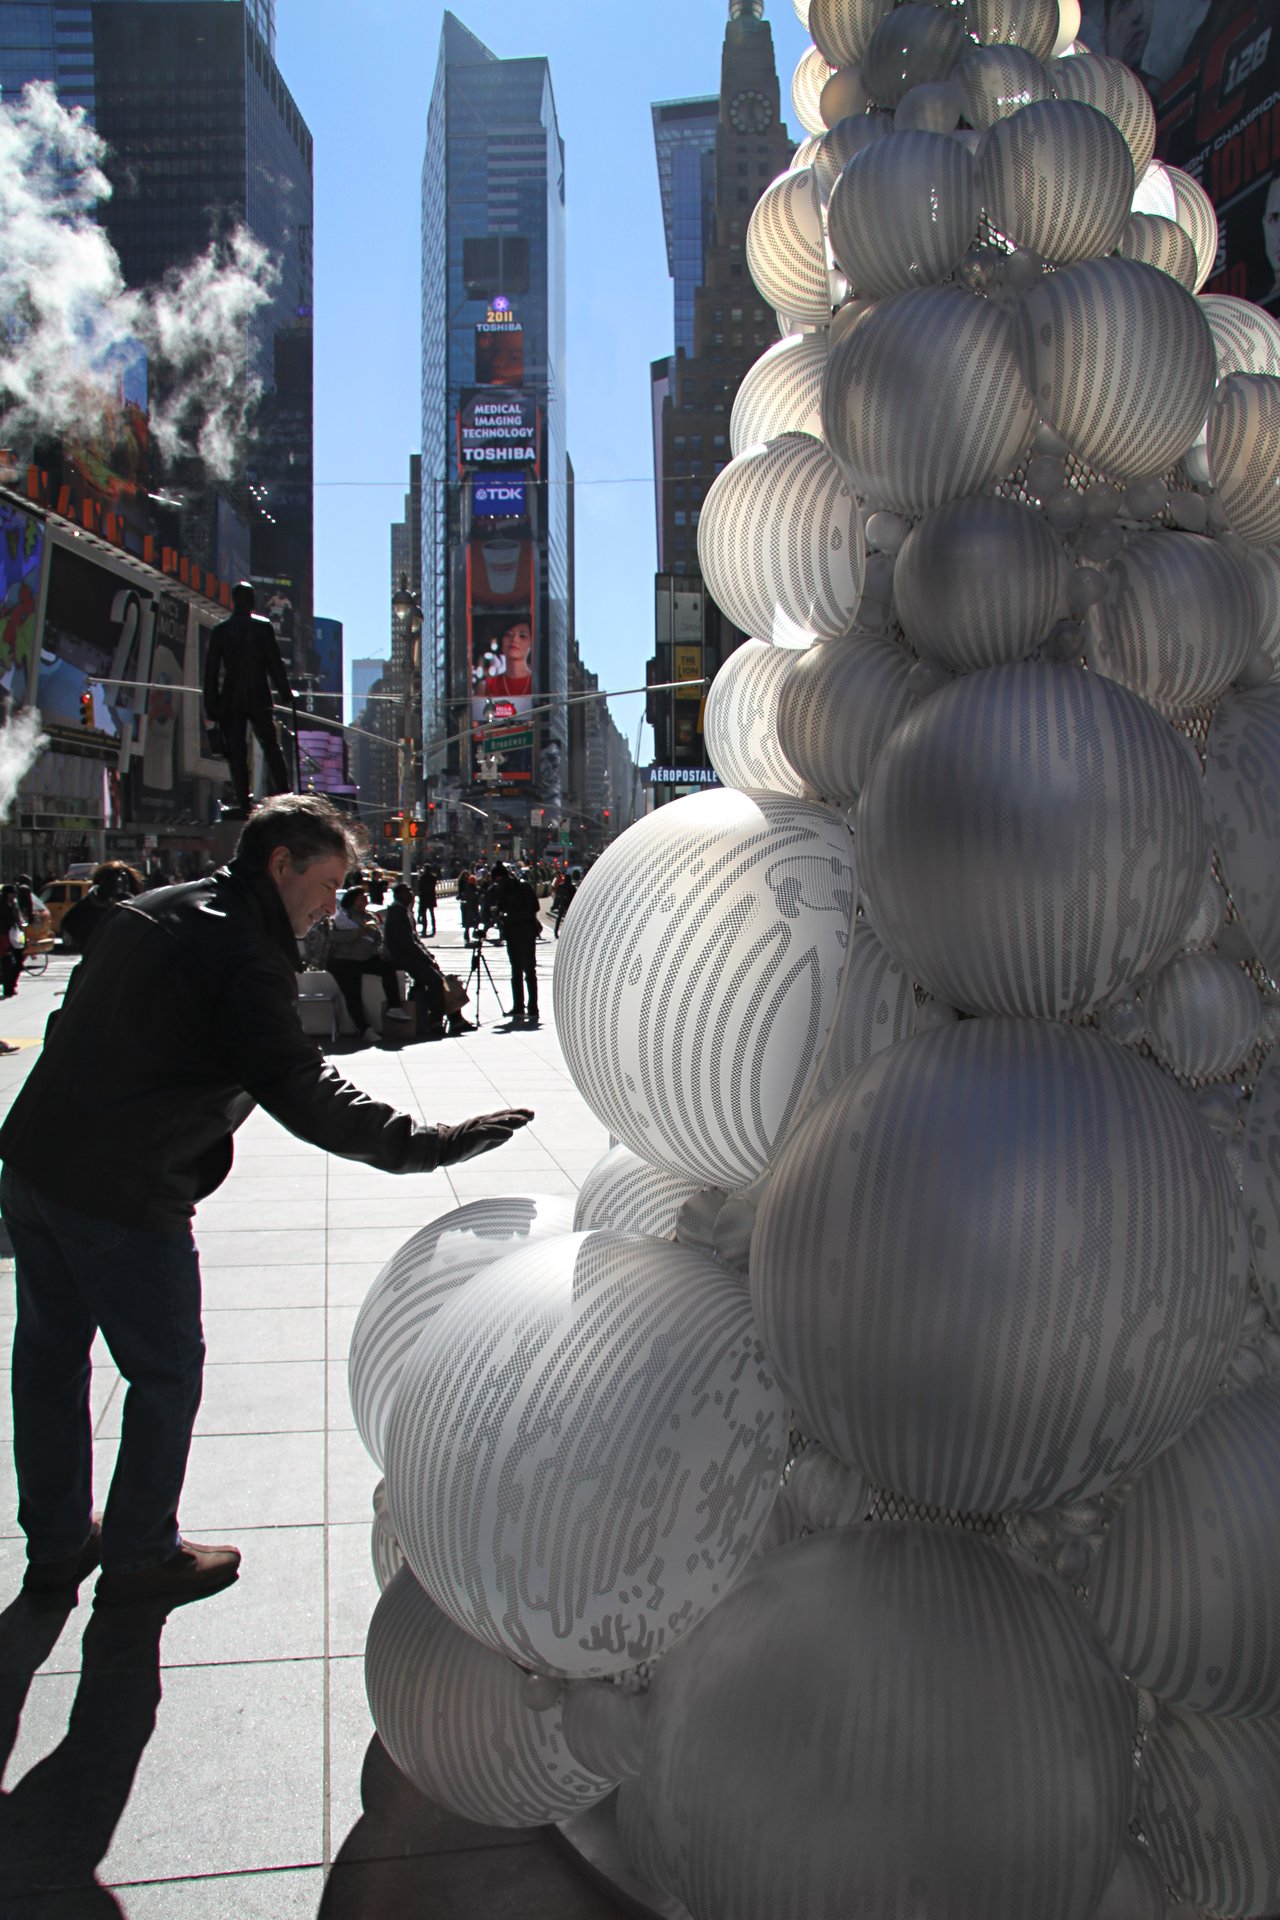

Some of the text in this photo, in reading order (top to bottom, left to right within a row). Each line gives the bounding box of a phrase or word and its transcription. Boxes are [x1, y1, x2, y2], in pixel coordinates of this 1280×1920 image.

[1223, 26, 1272, 96] 128
[487, 311, 513, 322] 2011
[476, 323, 522, 332] TOSHIBA
[474, 404, 522, 414] MEDICAL
[474, 416, 522, 426] IMAGING
[462, 428, 534, 438] TECHNOLOGY
[463, 448, 536, 460] TOSHIBA
[486, 488, 522, 500] TDK
[681, 656, 695, 665] THE
[491, 737, 527, 751] Broadway
[650, 766, 718, 782] AÉROPOSTALE
